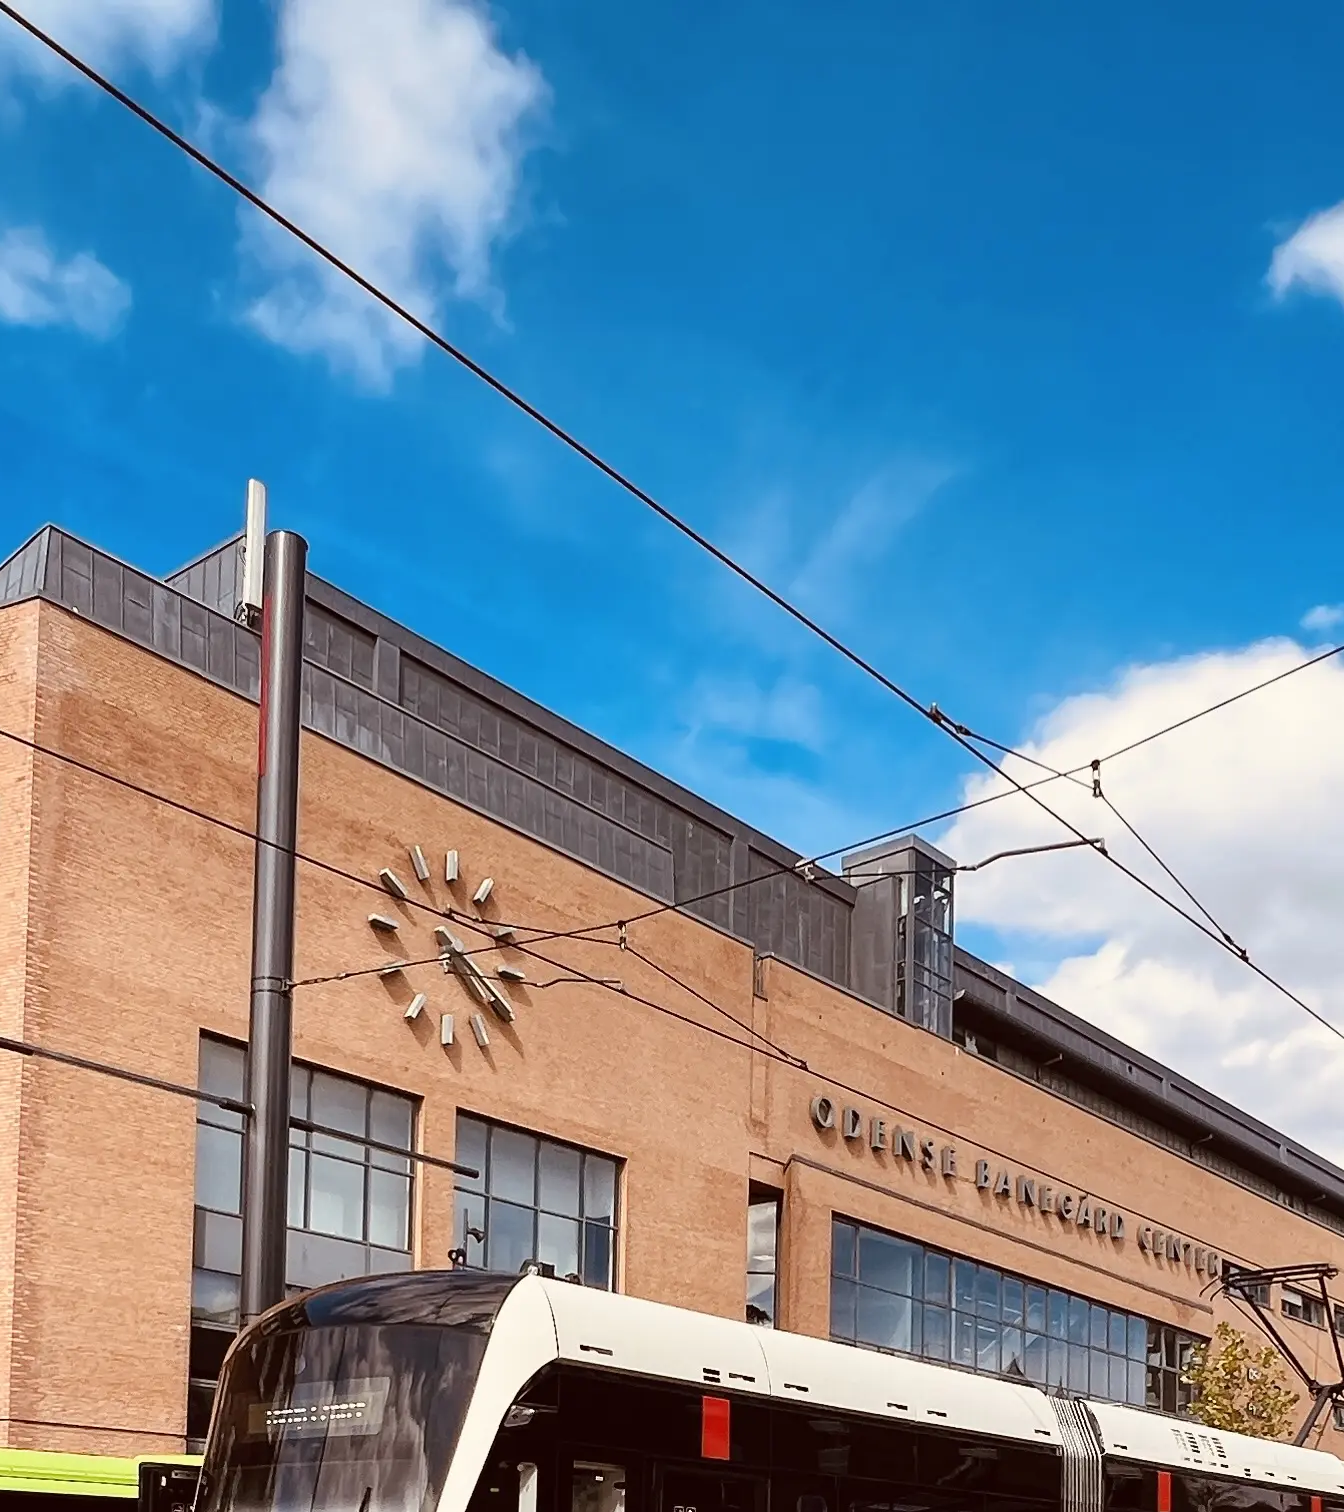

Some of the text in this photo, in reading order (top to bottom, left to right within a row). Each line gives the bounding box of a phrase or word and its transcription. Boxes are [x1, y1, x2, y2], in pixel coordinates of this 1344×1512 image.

[810, 1095, 1222, 1279] ODENSE BANEGÅRD CENTER
